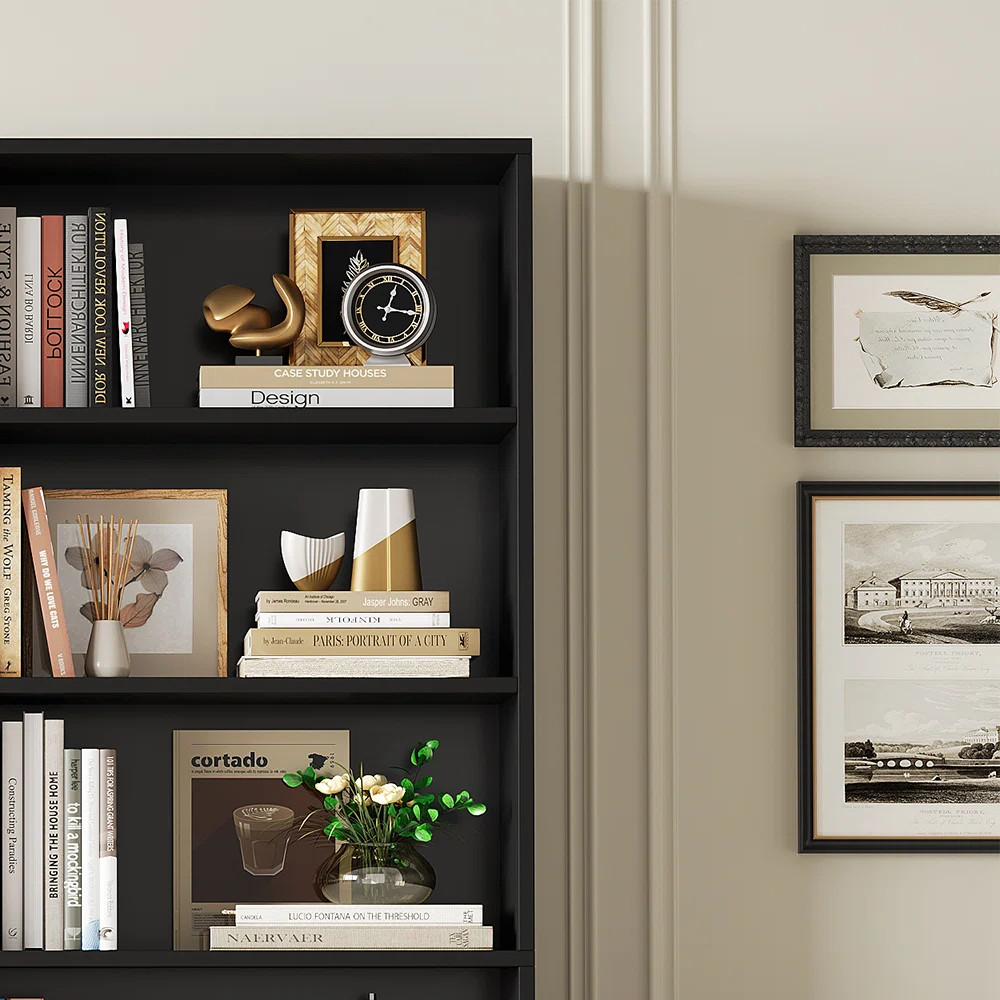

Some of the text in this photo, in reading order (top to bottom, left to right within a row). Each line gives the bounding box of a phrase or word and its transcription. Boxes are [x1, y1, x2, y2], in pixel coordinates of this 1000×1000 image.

[274, 369, 387, 378] CASE STUDY HOUSES
[251, 390, 320, 408] Design
[2, 474, 14, 525] TAMING
[2, 543, 14, 580] WOLF
[3, 587, 13, 615] GREG
[362, 597, 434, 608] Jasper Johns: GRAY
[3, 615, 13, 645] STONE
[263, 635, 448, 647] by Jean-Claude PARIS: PORTRAIT OF A CITY
[191, 752, 268, 767] cortado
[6, 777, 18, 874] Constructing Paradies
[49, 772, 58, 899] BRINGING THE HOUSE HOME
[64, 802, 81, 907] to kill a mockingbird
[288, 912, 312, 921] LUCIO
[314, 912, 351, 921] FONTANA
[352, 912, 366, 921] ON
[367, 912, 383, 921] THE
[384, 912, 430, 921] THRESHOLD
[227, 933, 324, 943] NAERVAER
